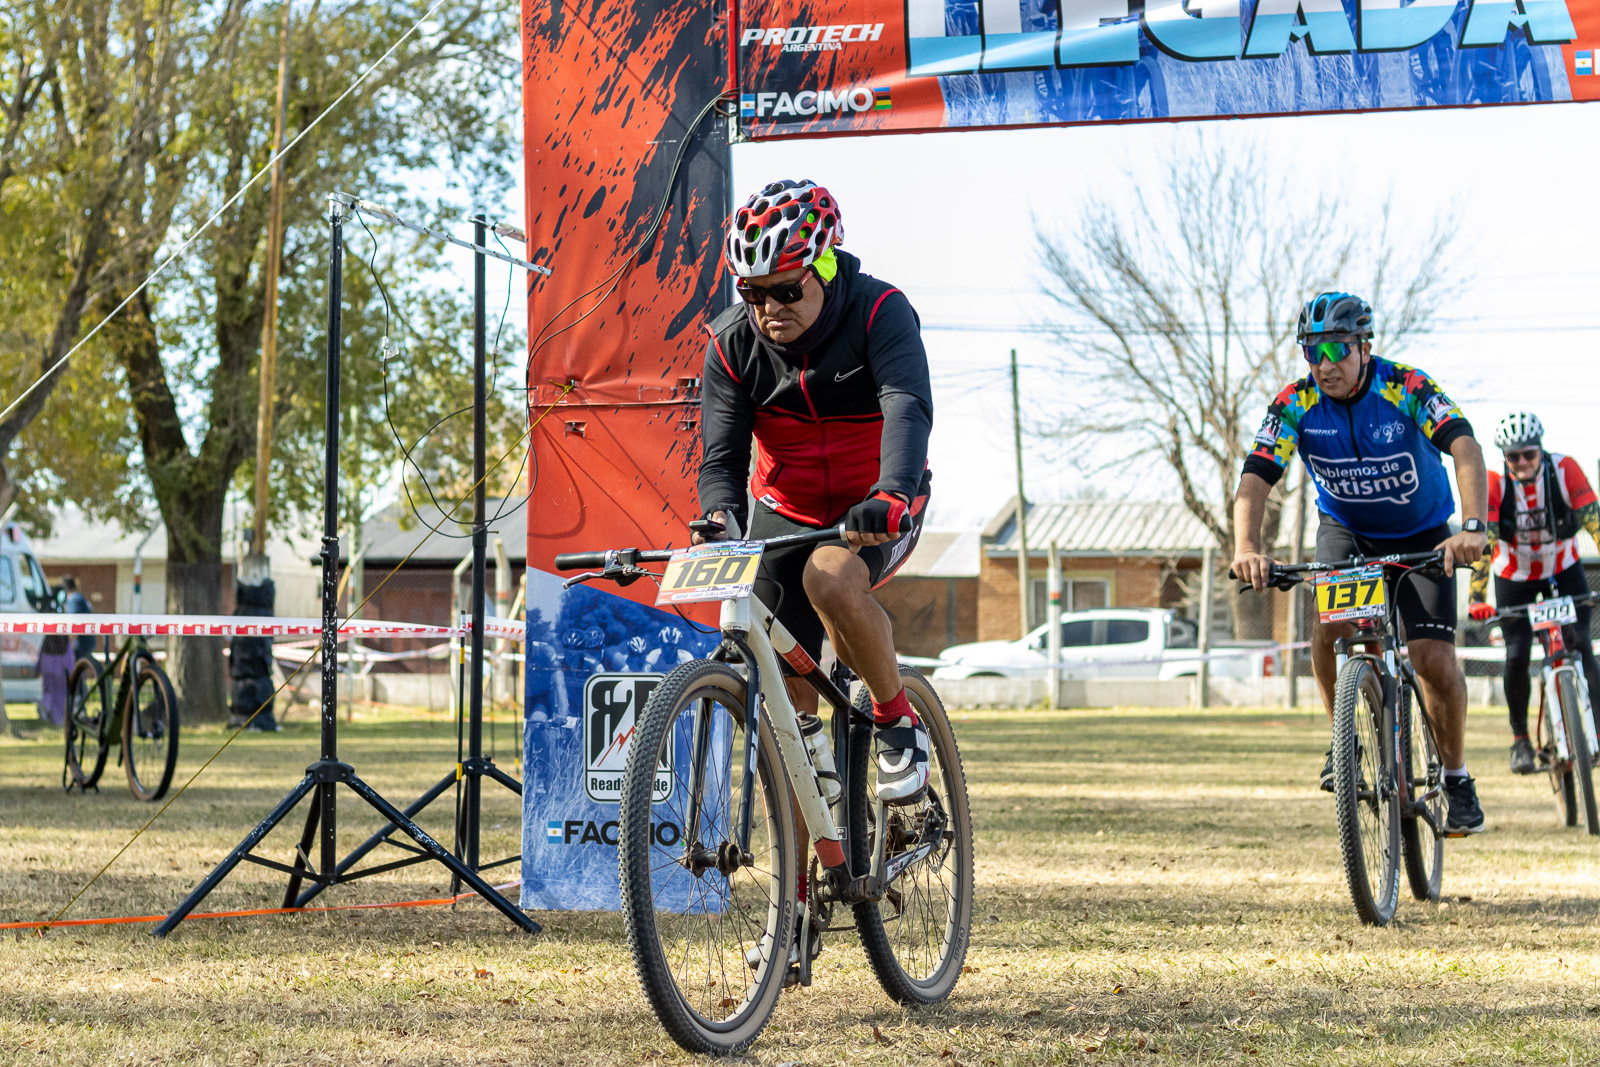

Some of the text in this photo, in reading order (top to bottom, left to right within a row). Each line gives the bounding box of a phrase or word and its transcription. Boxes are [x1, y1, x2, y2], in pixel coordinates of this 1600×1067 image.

[740, 23, 884, 47] PROTECH
[781, 42, 843, 52] ARGENTINA
[757, 87, 875, 118] FACIMO
[1381, 462, 1400, 475] de
[673, 556, 752, 589] 160
[1326, 580, 1379, 610] 137
[1534, 604, 1570, 623] 209
[591, 778, 623, 791] Read
[565, 821, 680, 846] FACO
[780, 899, 792, 951] COMPASS
